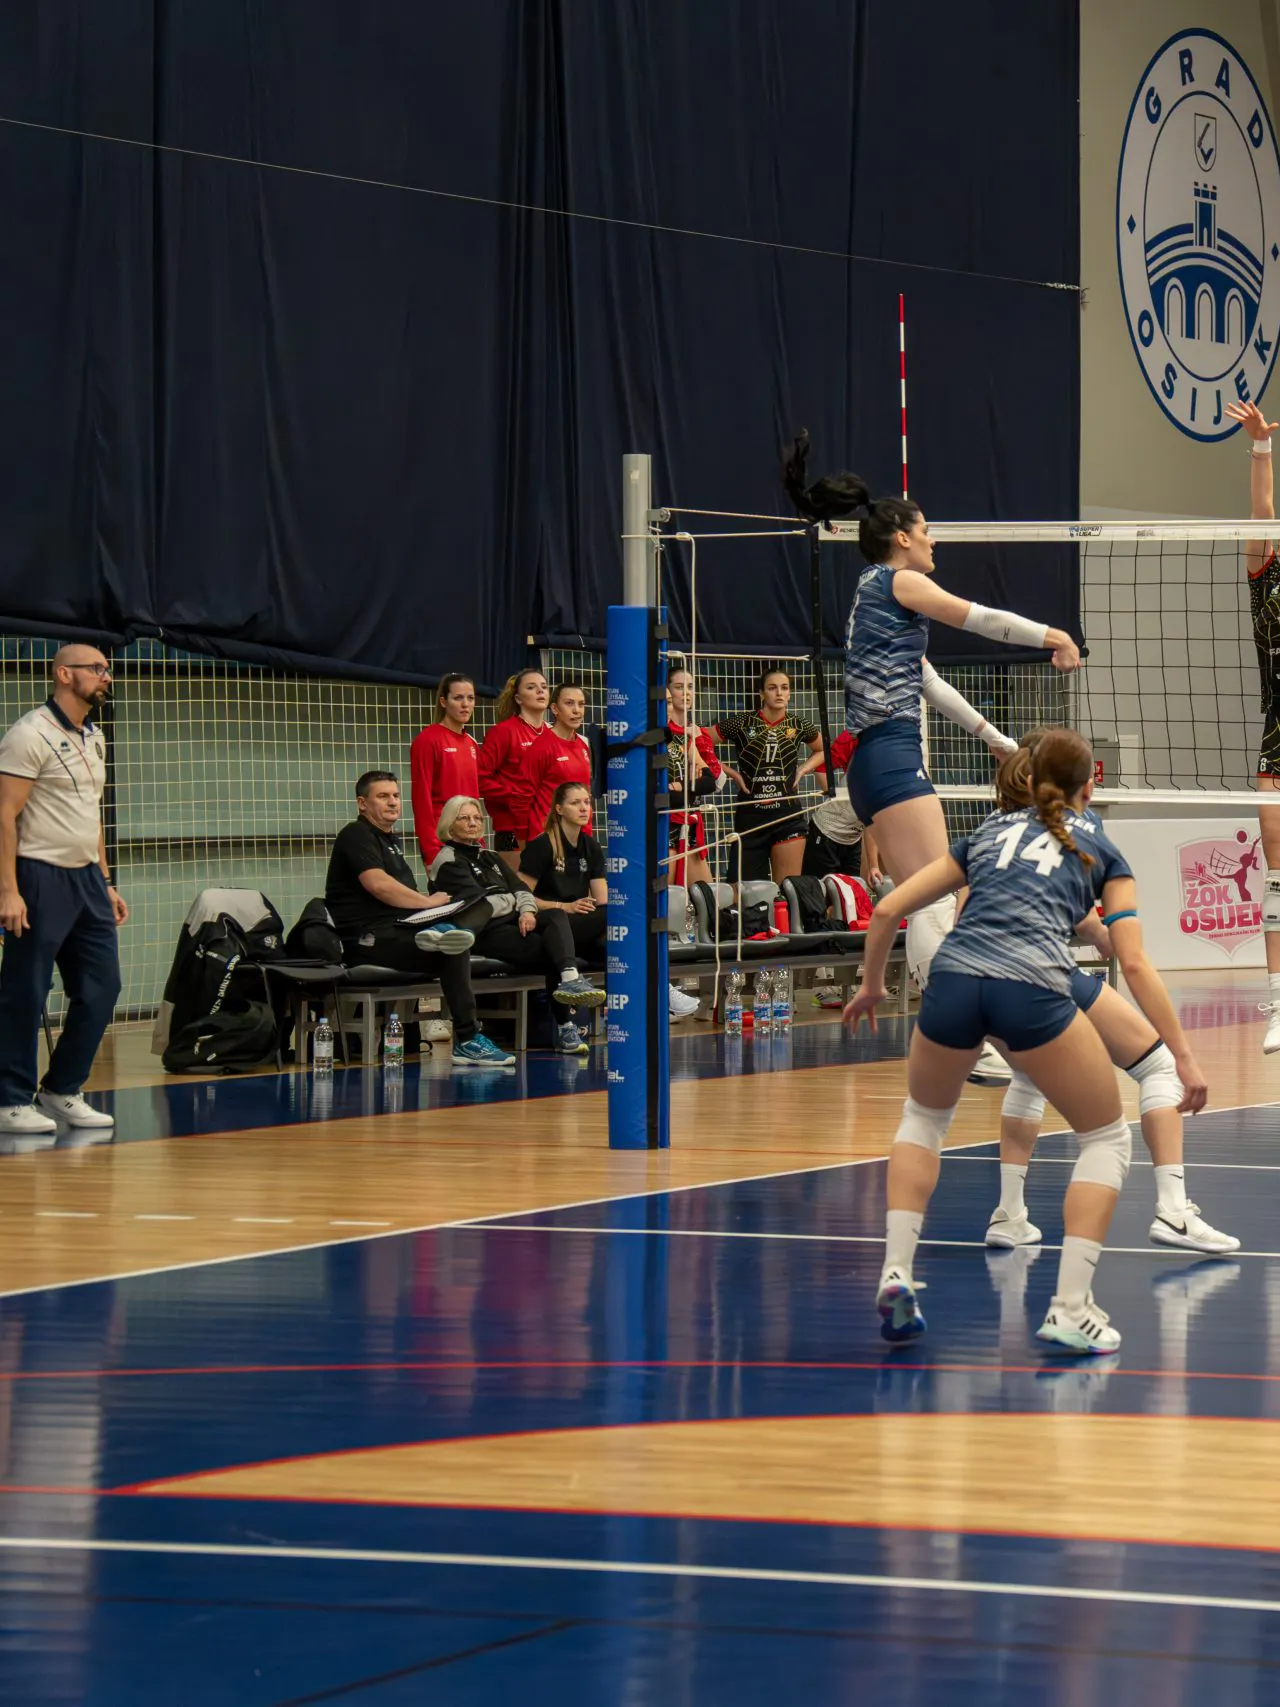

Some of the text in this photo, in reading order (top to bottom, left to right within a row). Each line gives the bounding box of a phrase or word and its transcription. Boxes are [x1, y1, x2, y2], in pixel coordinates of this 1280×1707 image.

[1144, 48, 1264, 149] GRAD
[1138, 309, 1273, 425] OSIJEK
[607, 721, 629, 737] HEP
[765, 743, 778, 763] 17
[607, 789, 628, 805] HEP
[994, 821, 1073, 877] 14
[606, 857, 628, 873] HEP
[1185, 882, 1233, 909] ŽOK
[1179, 902, 1264, 934] OSIJEK
[607, 926, 629, 942] HEP
[607, 994, 629, 1010] HEP
